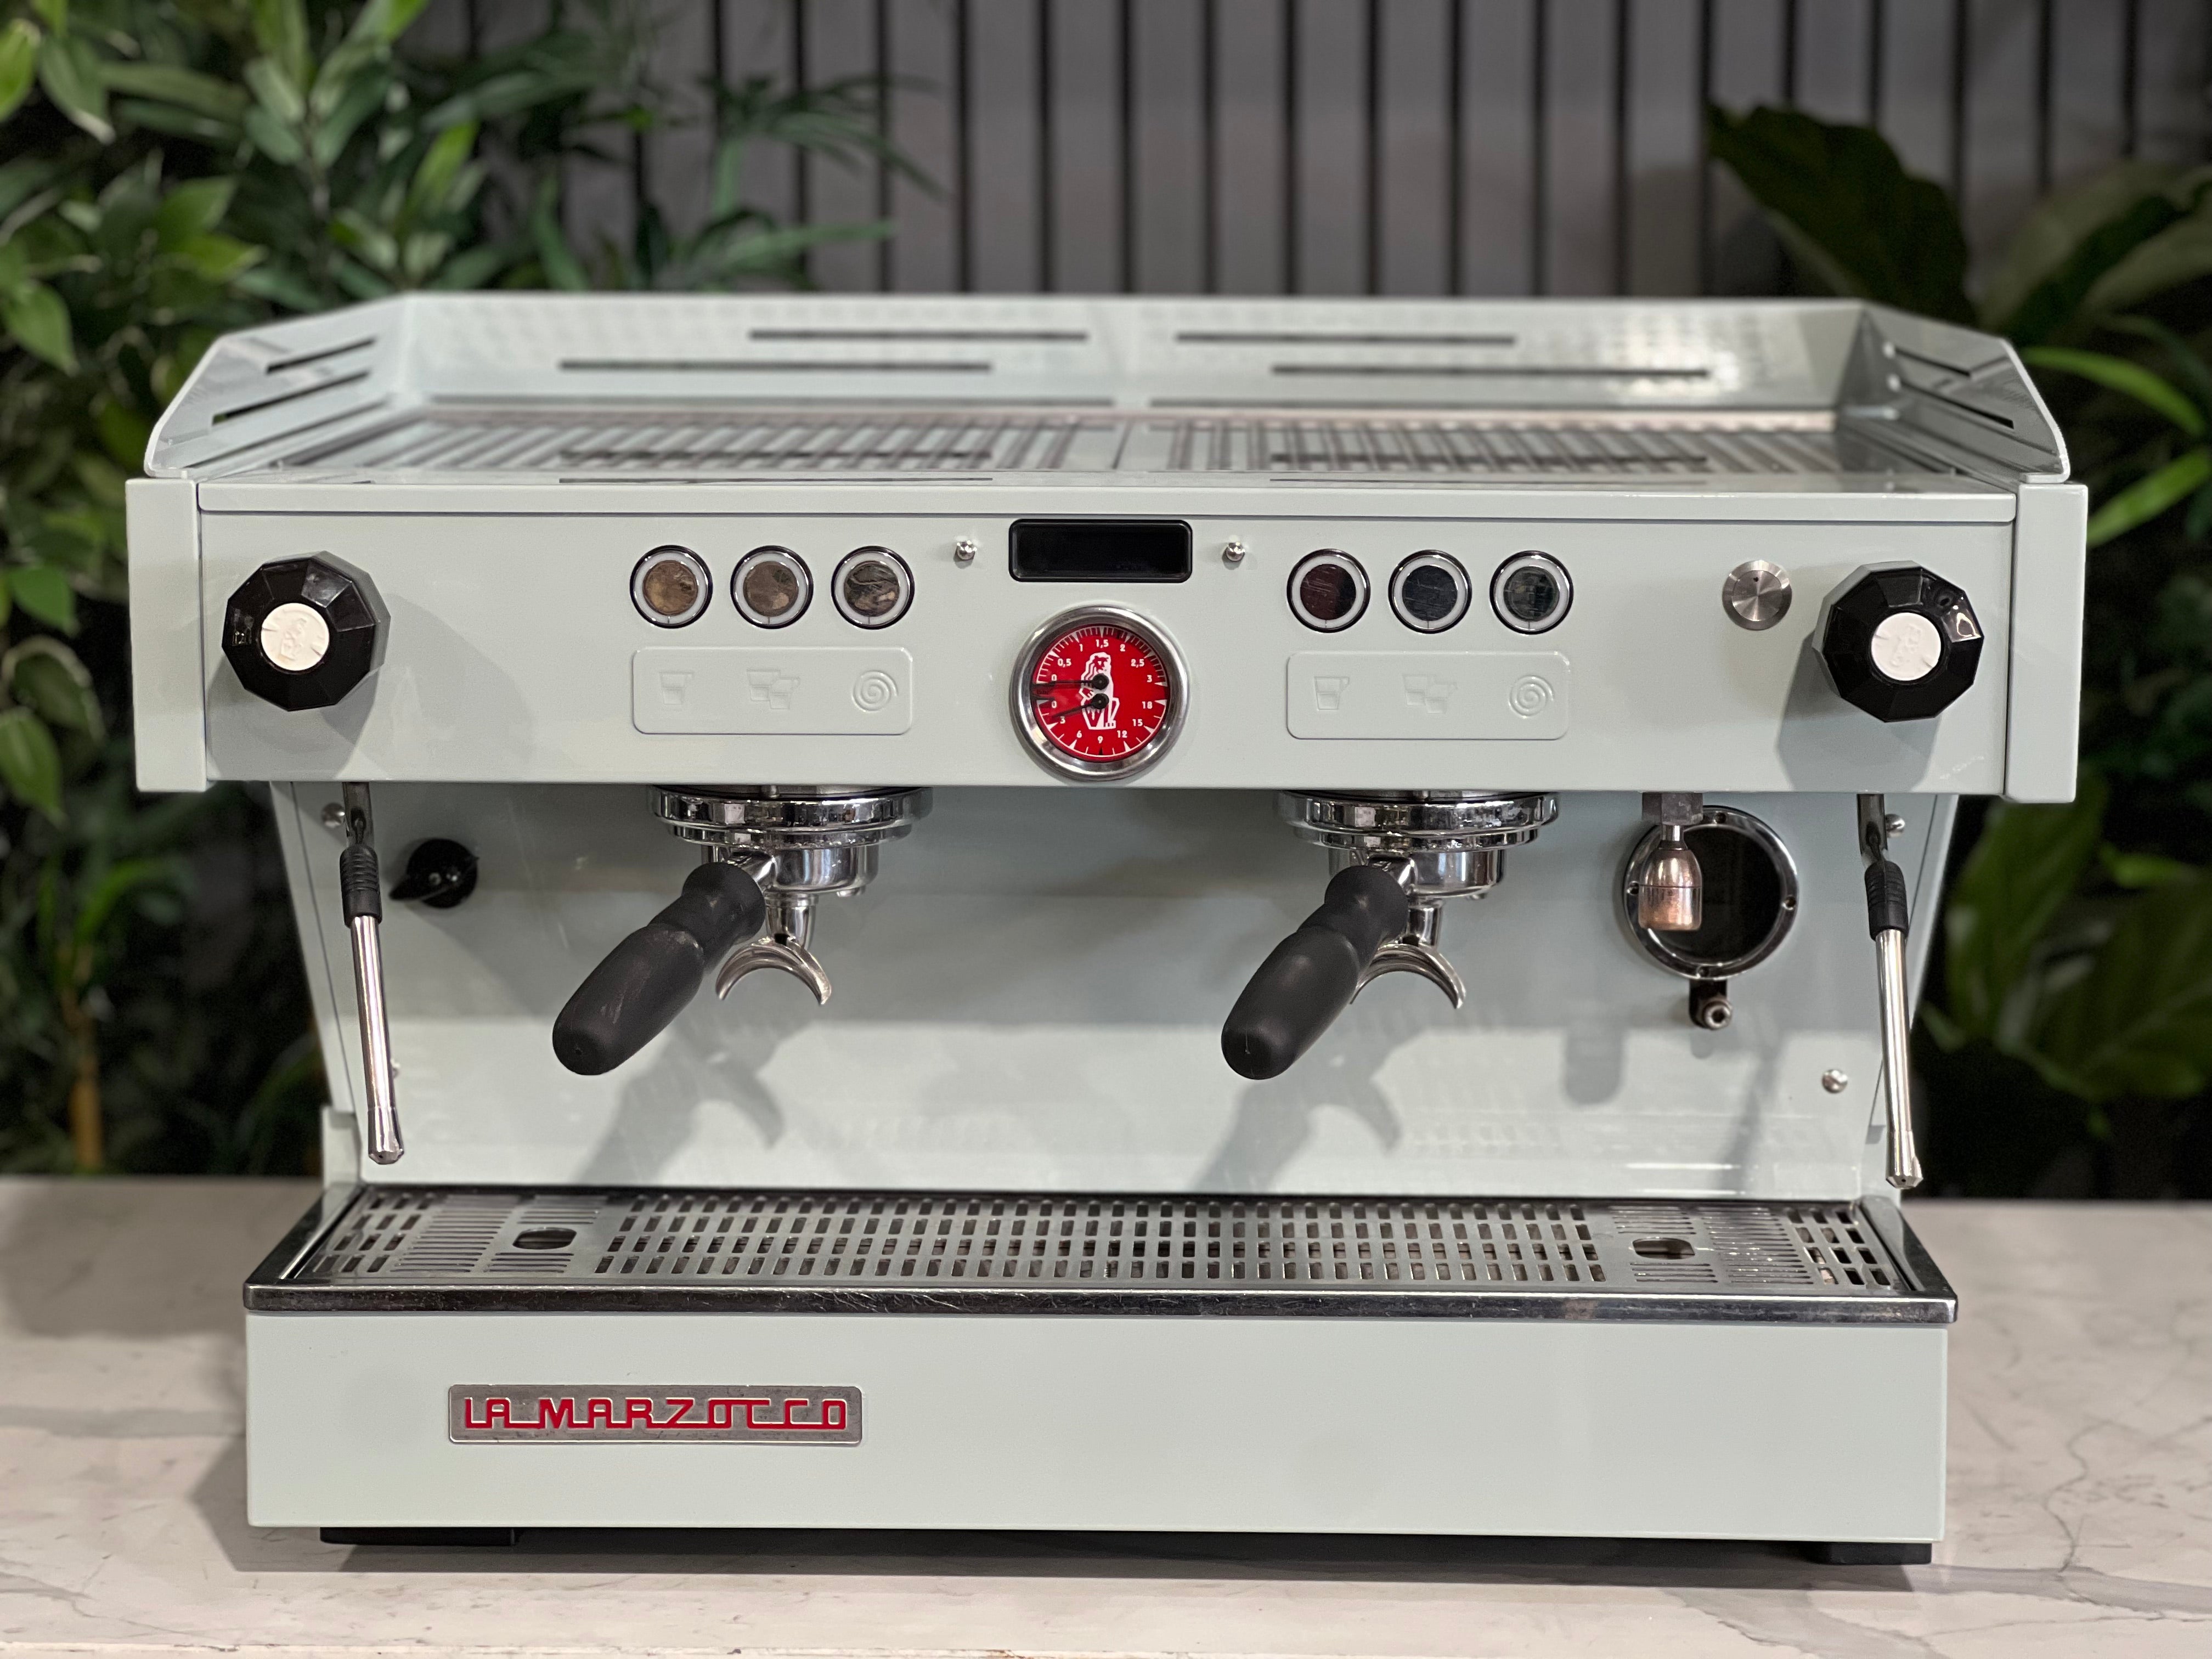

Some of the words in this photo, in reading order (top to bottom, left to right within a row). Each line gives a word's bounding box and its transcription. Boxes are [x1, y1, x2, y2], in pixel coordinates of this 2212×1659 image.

[1096, 639, 1109, 648] 1,5
[1079, 644, 1083, 652] 1
[1057, 658, 1072, 668] 0,5
[1131, 659, 1145, 668] 2,5
[1051, 701, 1057, 709] 0
[1142, 701, 1153, 709] 18
[1060, 716, 1066, 724] 3
[1132, 719, 1143, 727] 15
[1076, 730, 1082, 738] 6
[1116, 730, 1127, 738] 12
[1097, 736, 1103, 744] 9
[465, 1397, 511, 1429] LA
[539, 1397, 848, 1430] MARZOCCO
